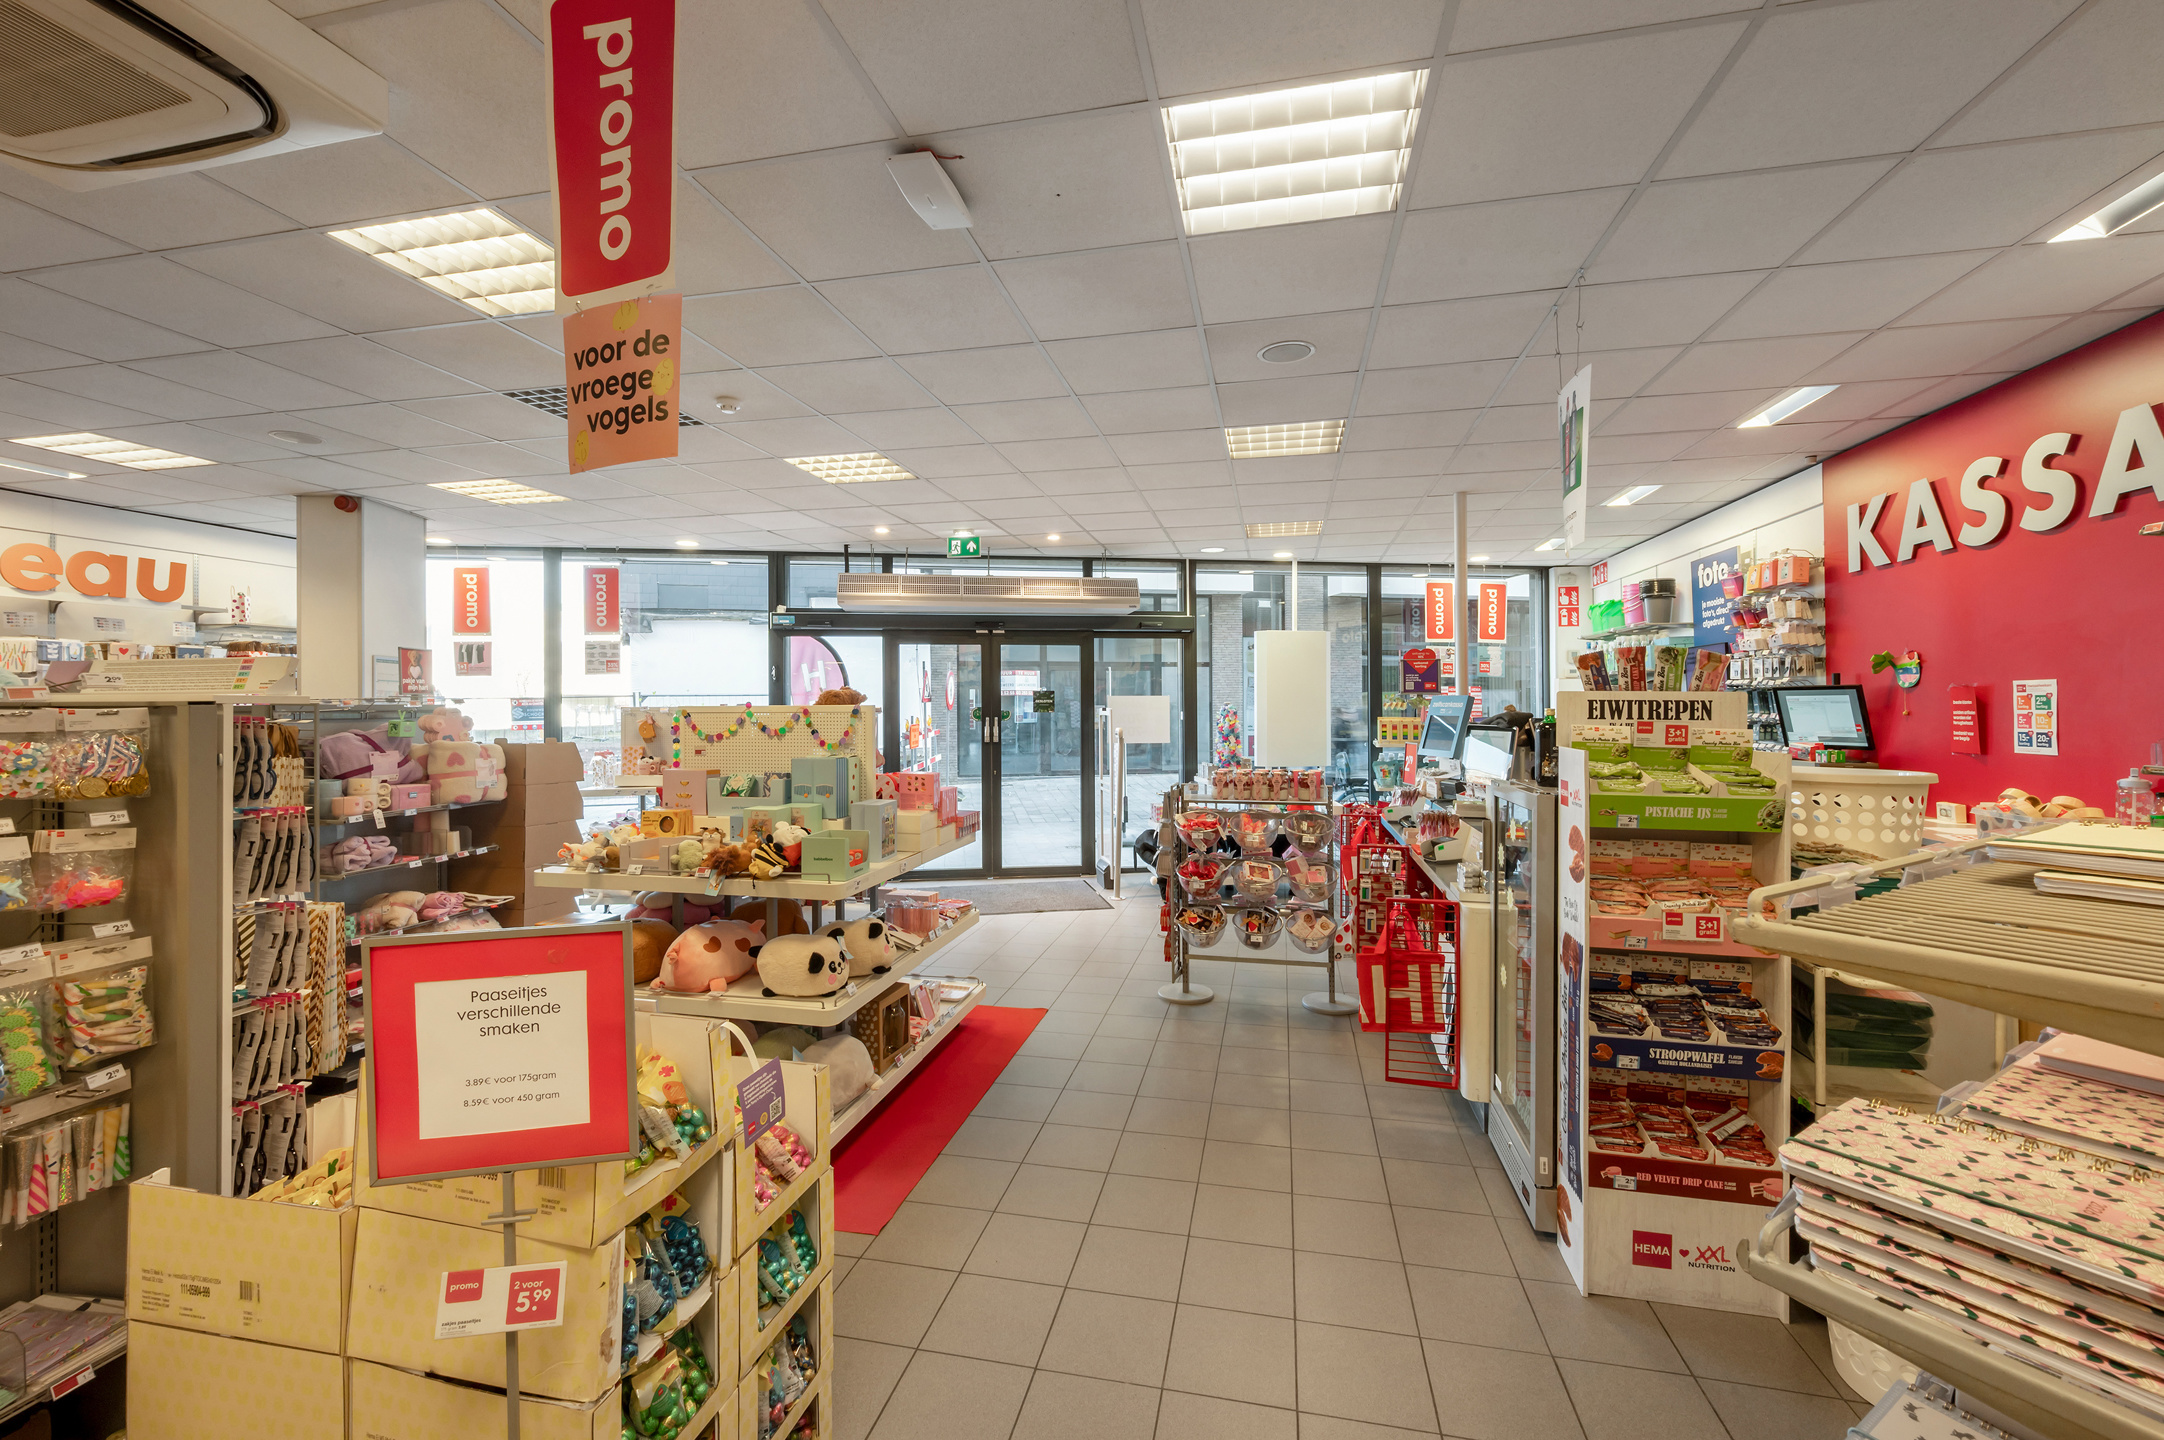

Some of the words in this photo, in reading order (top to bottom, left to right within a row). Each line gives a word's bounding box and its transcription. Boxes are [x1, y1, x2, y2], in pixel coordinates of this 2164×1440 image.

[583, 17, 633, 261] promo
[574, 340, 626, 370] voor
[633, 329, 670, 357] de
[571, 369, 654, 404] vroege
[587, 396, 668, 434] vogels
[1847, 402, 2164, 573] KASSA
[0, 543, 187, 603] eau
[463, 574, 478, 628] promo
[592, 574, 607, 627] promo
[1433, 588, 1444, 634] promo
[1486, 588, 1498, 636] promo
[1587, 700, 1712, 721] EIWITREPEN
[1668, 728, 1685, 737] 3+1
[1645, 806, 1694, 818] PISTACHE
[1697, 808, 1711, 819] IJS
[1699, 920, 1717, 930] 3+1
[21, 948, 39, 958] 2.89
[470, 985, 547, 1002] Paaseitjes
[457, 1002, 561, 1021] verschillende
[479, 1021, 540, 1037] smaken
[1649, 1048, 1725, 1064] STROOPWAFEL
[465, 1077, 491, 1087] 3.89€
[494, 1075, 516, 1084] voor
[518, 1072, 557, 1085] 175gram
[464, 1097, 489, 1107] 8.59€
[492, 1095, 514, 1104] voor
[517, 1093, 534, 1103] 450
[535, 1090, 560, 1102] gram
[1636, 1172, 1651, 1181] RED
[1654, 1174, 1680, 1184] VELVET
[1683, 1177, 1702, 1187] DRIP
[1704, 1180, 1723, 1189] CAKE
[1635, 1243, 1670, 1256] HEMA
[1695, 1245, 1730, 1263] XXL
[1688, 1262, 1736, 1272] NUTRITION
[450, 1283, 479, 1292] promo
[514, 1281, 520, 1289] 2
[515, 1289, 551, 1312] 5.99
